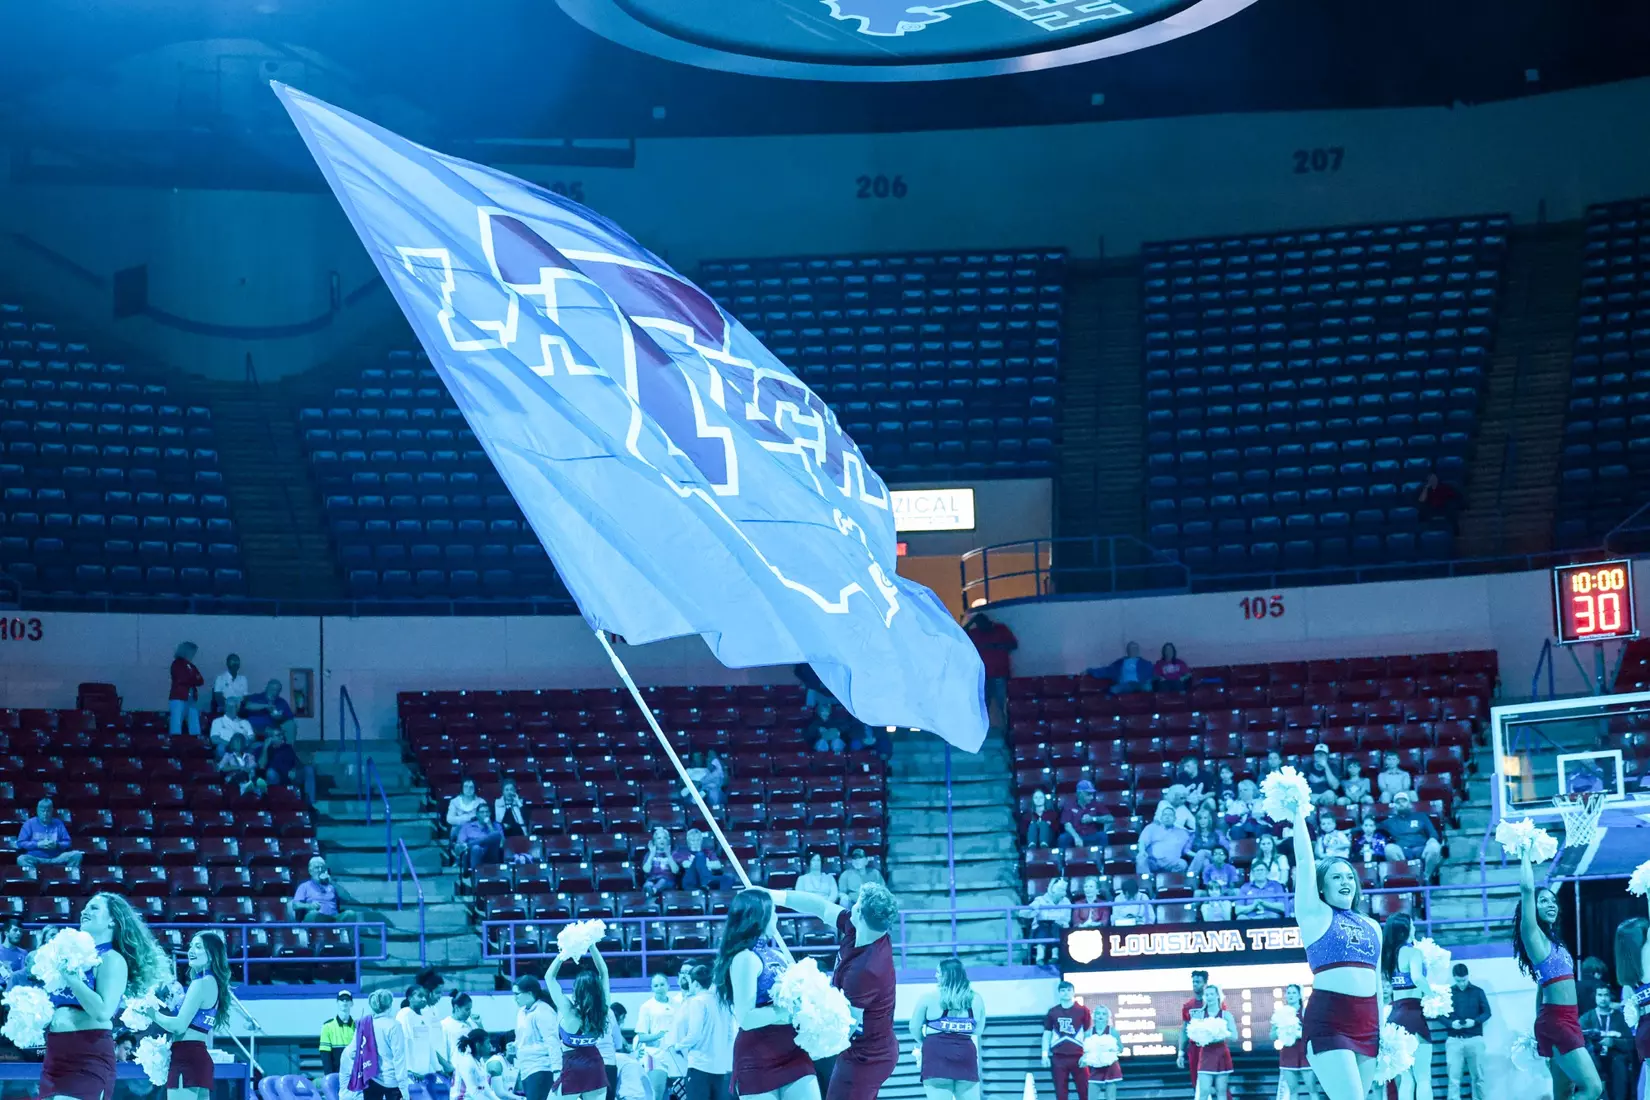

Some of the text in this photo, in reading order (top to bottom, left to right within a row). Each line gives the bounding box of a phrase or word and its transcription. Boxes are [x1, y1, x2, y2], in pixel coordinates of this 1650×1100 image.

[1292, 148, 1344, 174] 207
[855, 174, 908, 199] 206
[1572, 568, 1624, 593] 10:00
[1239, 594, 1285, 620] 105
[1573, 593, 1621, 633] 30
[0, 617, 43, 641] 103
[1110, 930, 1245, 956] LOUISIANA
[940, 1020, 973, 1031] TECH
[569, 1037, 597, 1046] TEC
